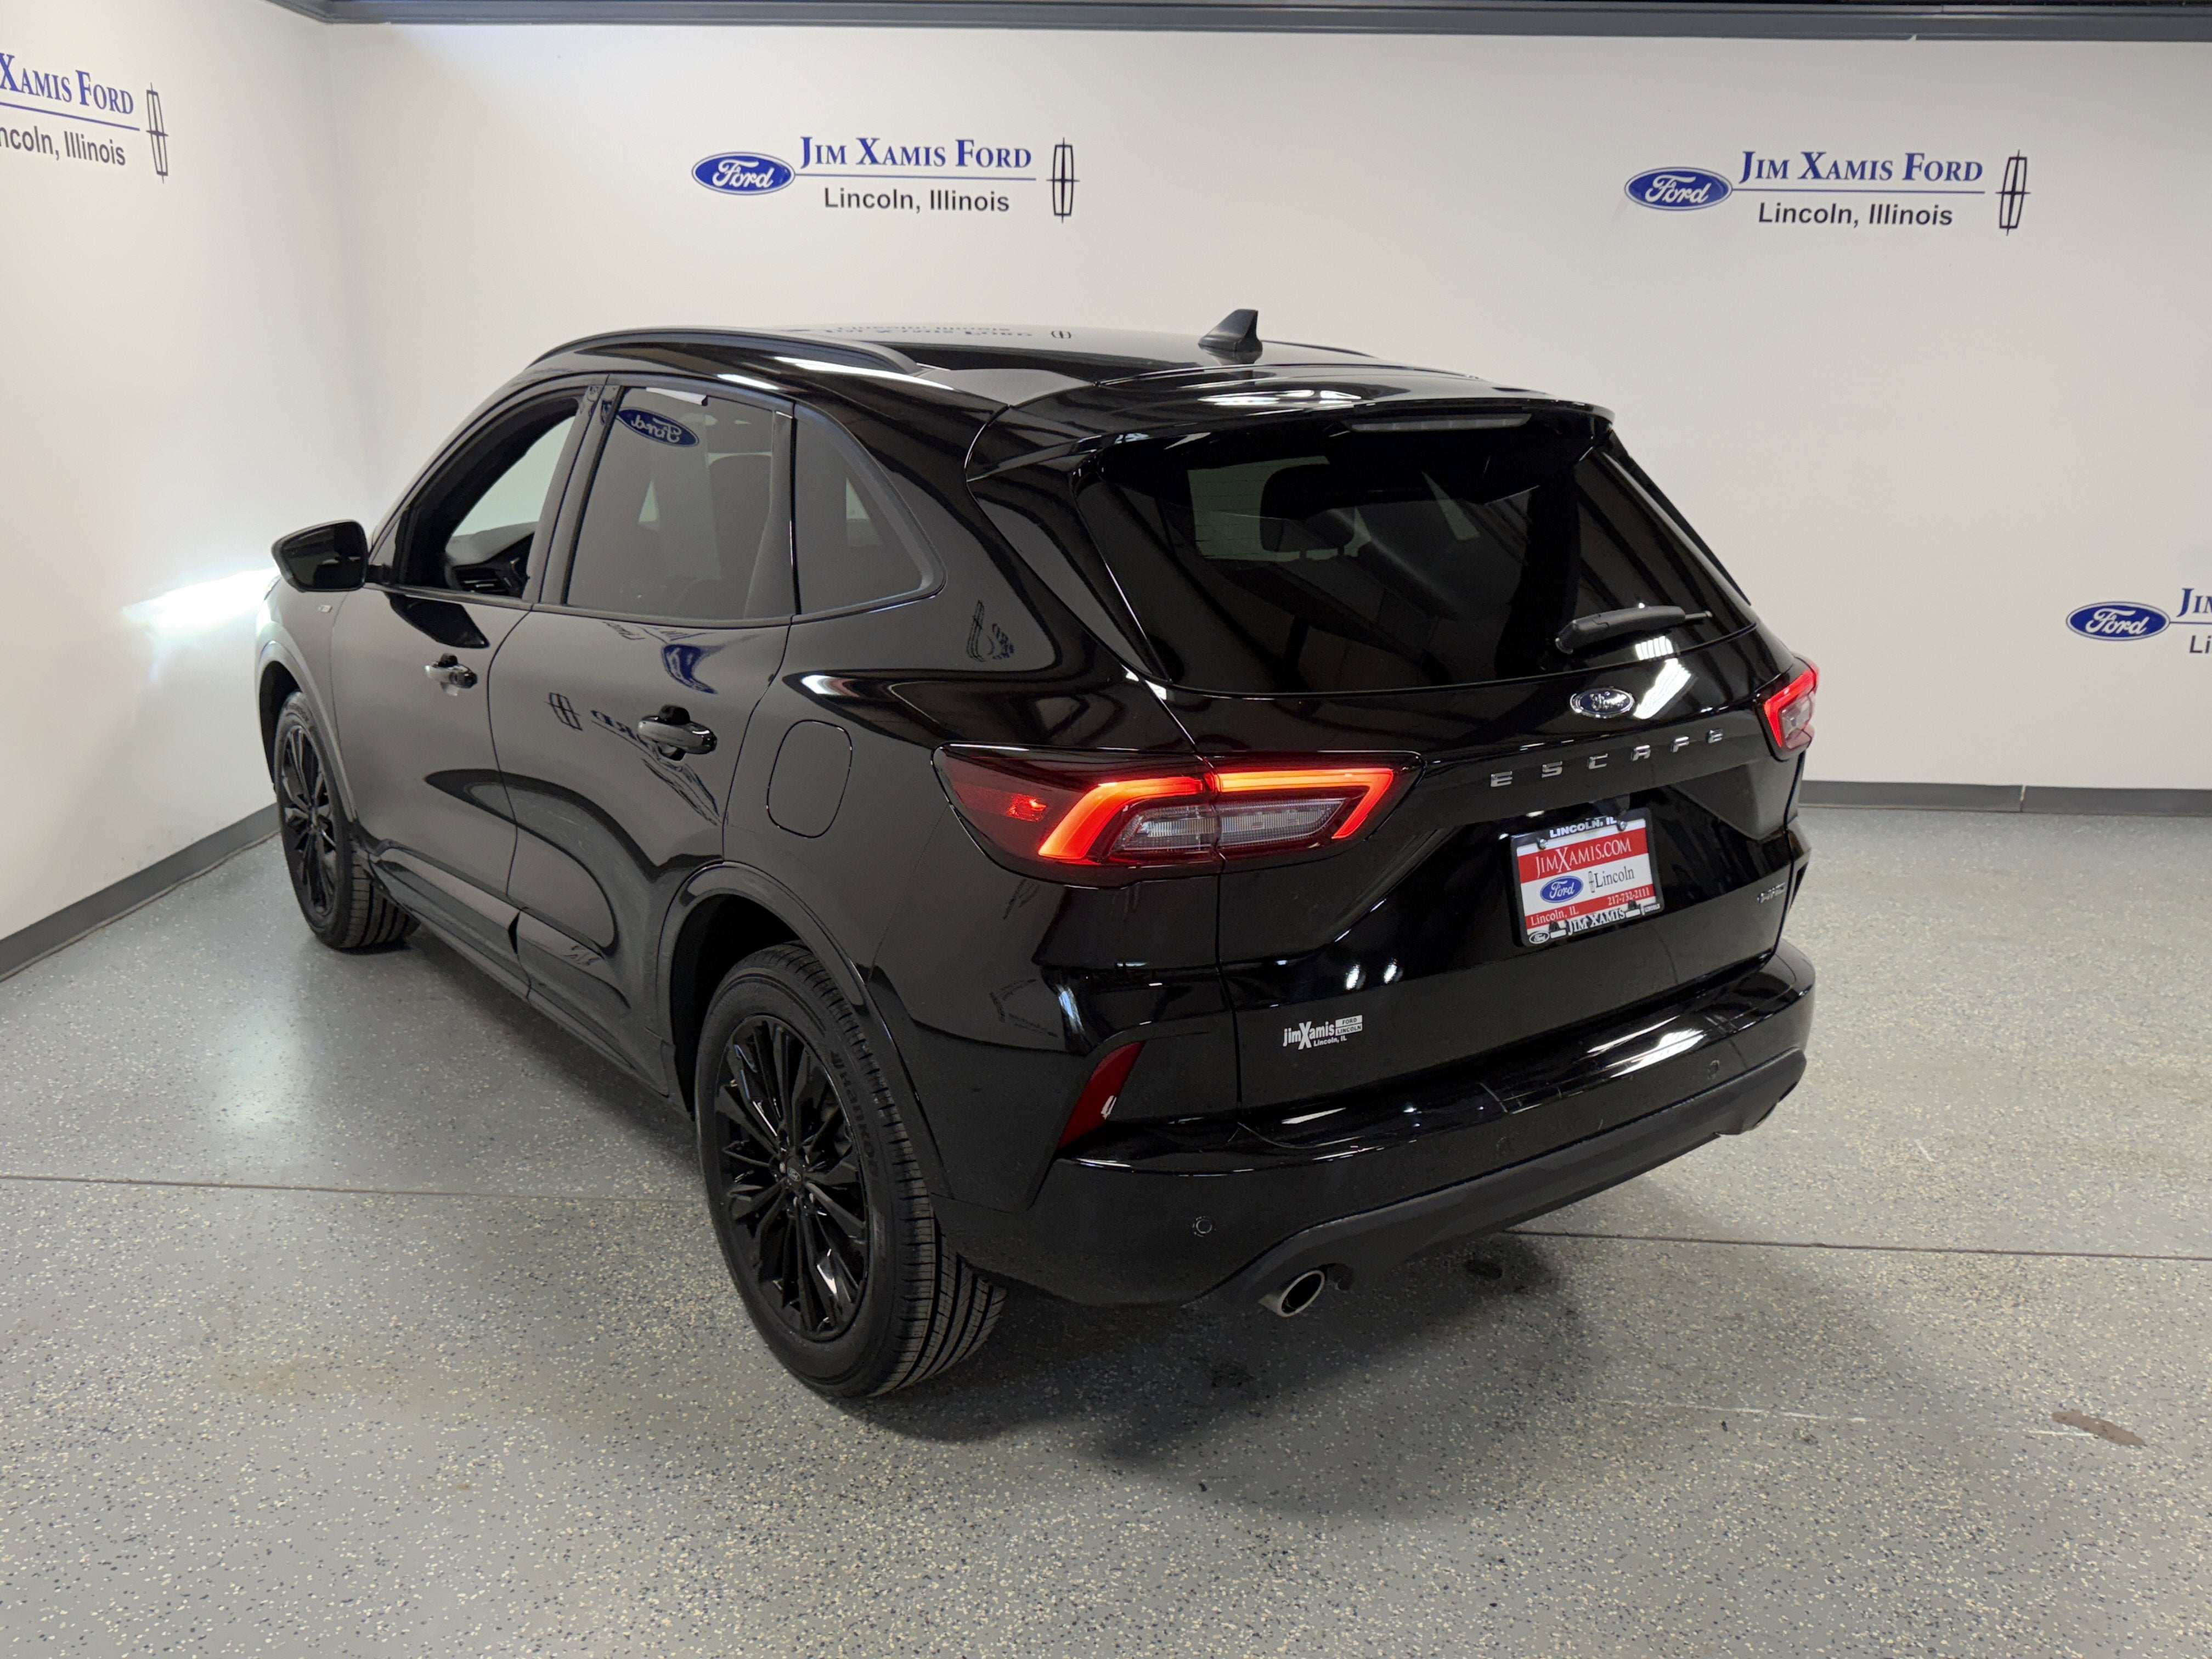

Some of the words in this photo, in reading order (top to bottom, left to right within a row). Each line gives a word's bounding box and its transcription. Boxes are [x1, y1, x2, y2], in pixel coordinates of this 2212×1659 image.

[75, 70, 134, 115] FORD
[0, 126, 60, 161] ncoln,
[64, 130, 126, 166] Illinois
[800, 137, 847, 169] JIM
[856, 138, 946, 167] XAMIS
[955, 139, 1032, 168] FORD
[1739, 151, 1790, 184] JIM
[1797, 151, 1893, 180] XAMIS
[1901, 153, 1983, 182] FORD
[824, 187, 921, 213] Lincoln,
[930, 190, 1010, 212] Illinois
[1758, 202, 1859, 228] Lincoln,
[1869, 204, 1953, 225] Illinois
[1490, 728, 1724, 788] ESCAPE
[1594, 866, 1635, 888] Lincoln
[1607, 887, 1650, 906] 217-732-2111
[1530, 910, 1567, 927] Lincoln,
[1568, 906, 1579, 915] IL
[1567, 917, 1588, 936] JIM
[1589, 909, 1626, 928] XAMIS
[1313, 1037, 1340, 1047] Lincoln,
[1337, 1025, 1362, 1034] LINCOLN
